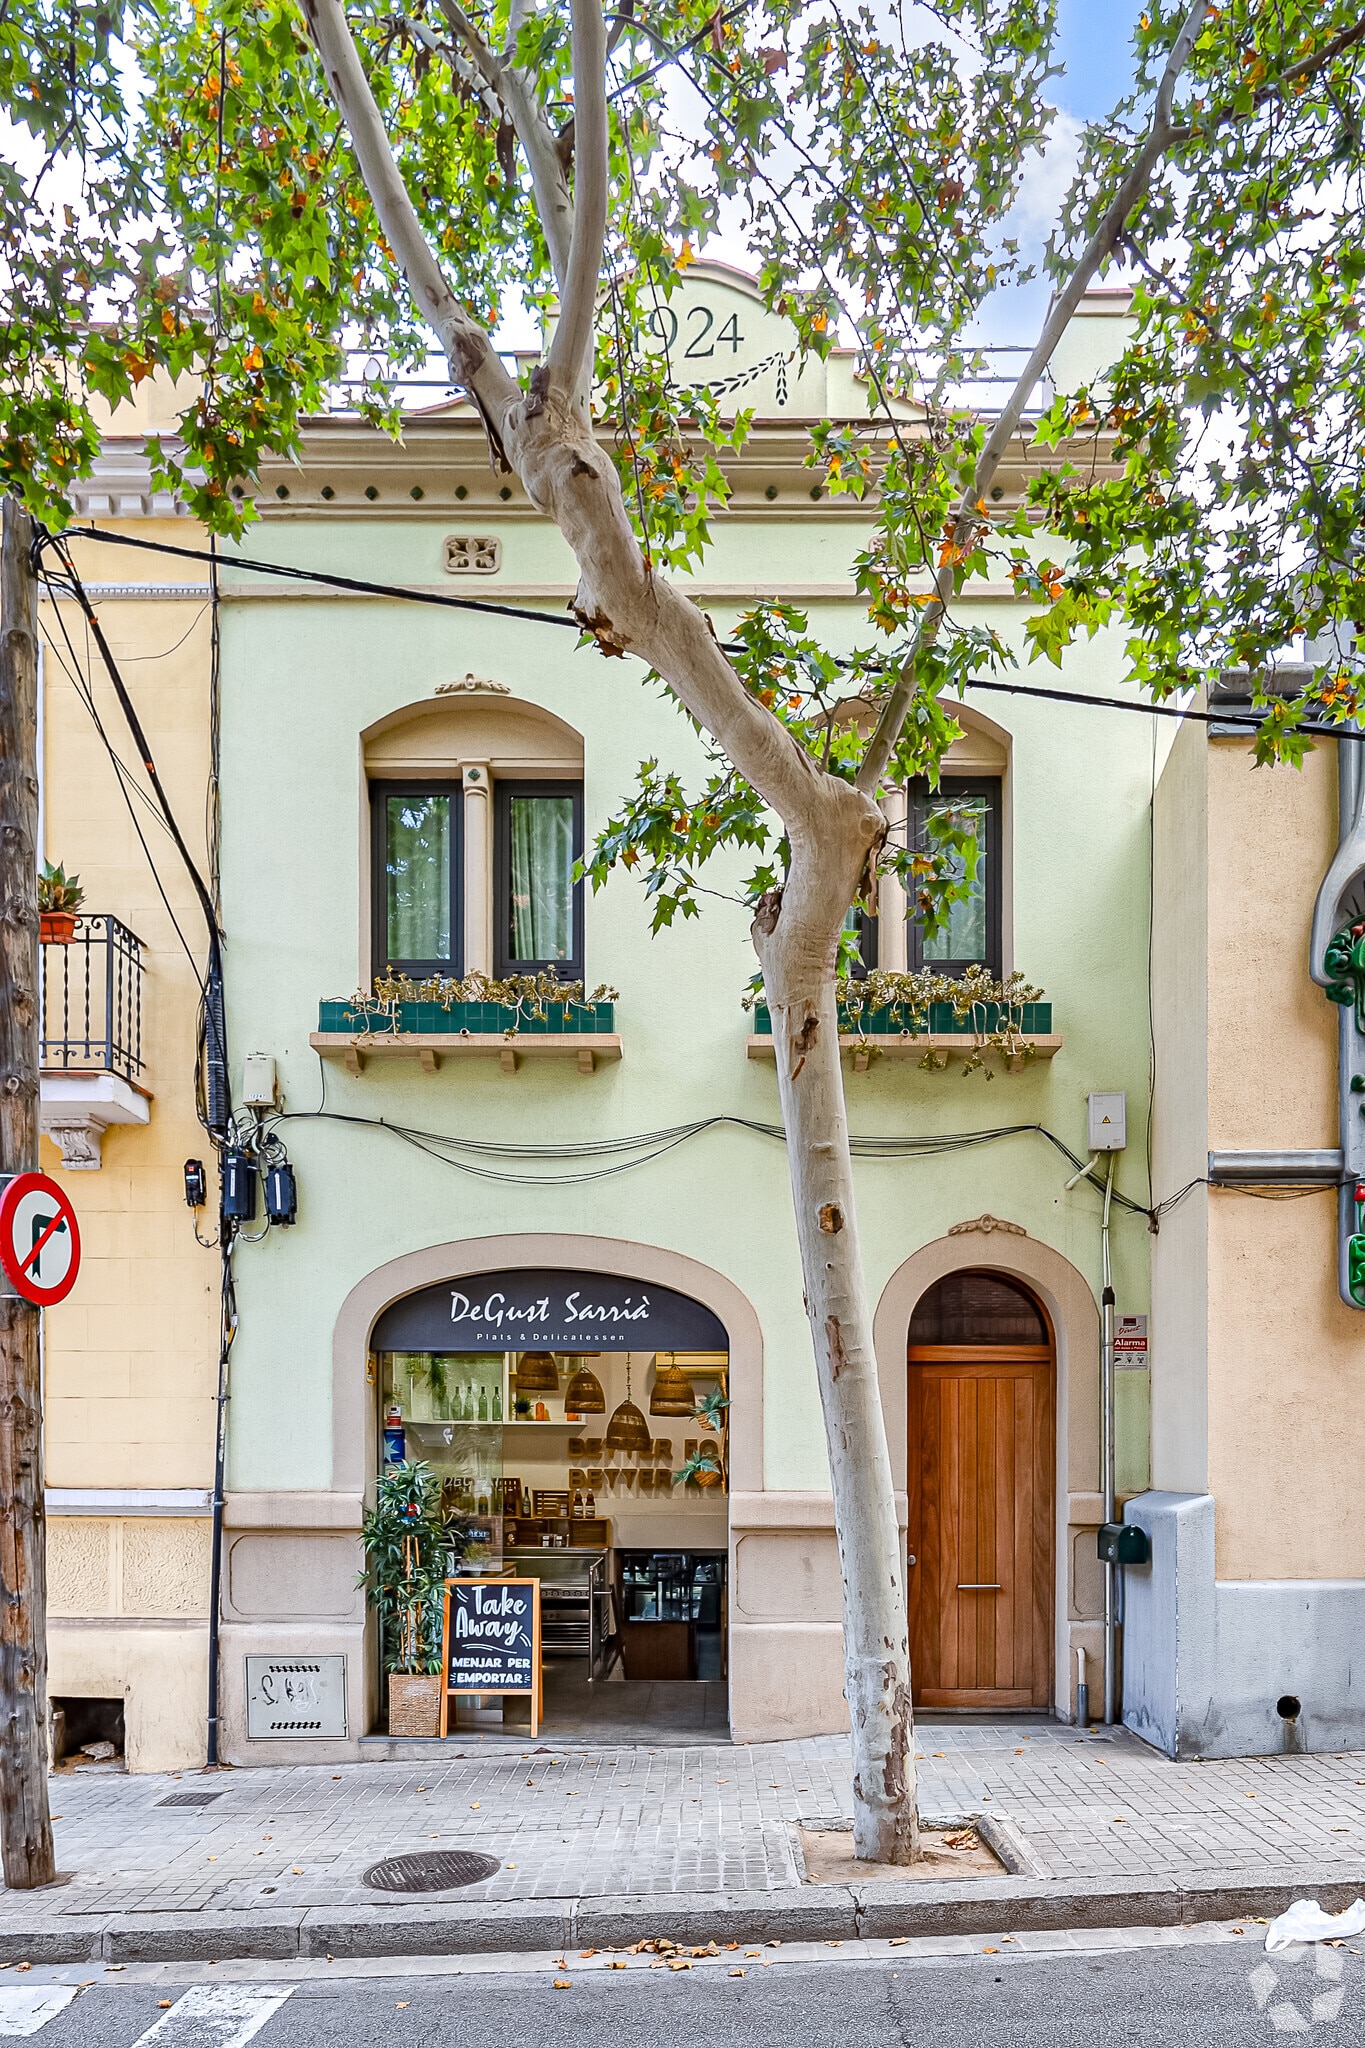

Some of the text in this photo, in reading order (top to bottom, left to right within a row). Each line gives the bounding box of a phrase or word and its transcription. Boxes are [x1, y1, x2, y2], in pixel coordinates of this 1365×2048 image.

[633, 306, 745, 358] 1924
[450, 1291, 651, 1328] DeGust Sarrià
[476, 1333, 626, 1341] Plats & Delicatessen
[1114, 1338, 1146, 1346] Alarma
[568, 1437, 674, 1459] BER
[568, 1468, 673, 1489] BETTER
[471, 1585, 528, 1617] Take
[455, 1606, 524, 1646] Away
[452, 1657, 531, 1669] MENJAR PER
[456, 1672, 523, 1684] EMPORTAR
